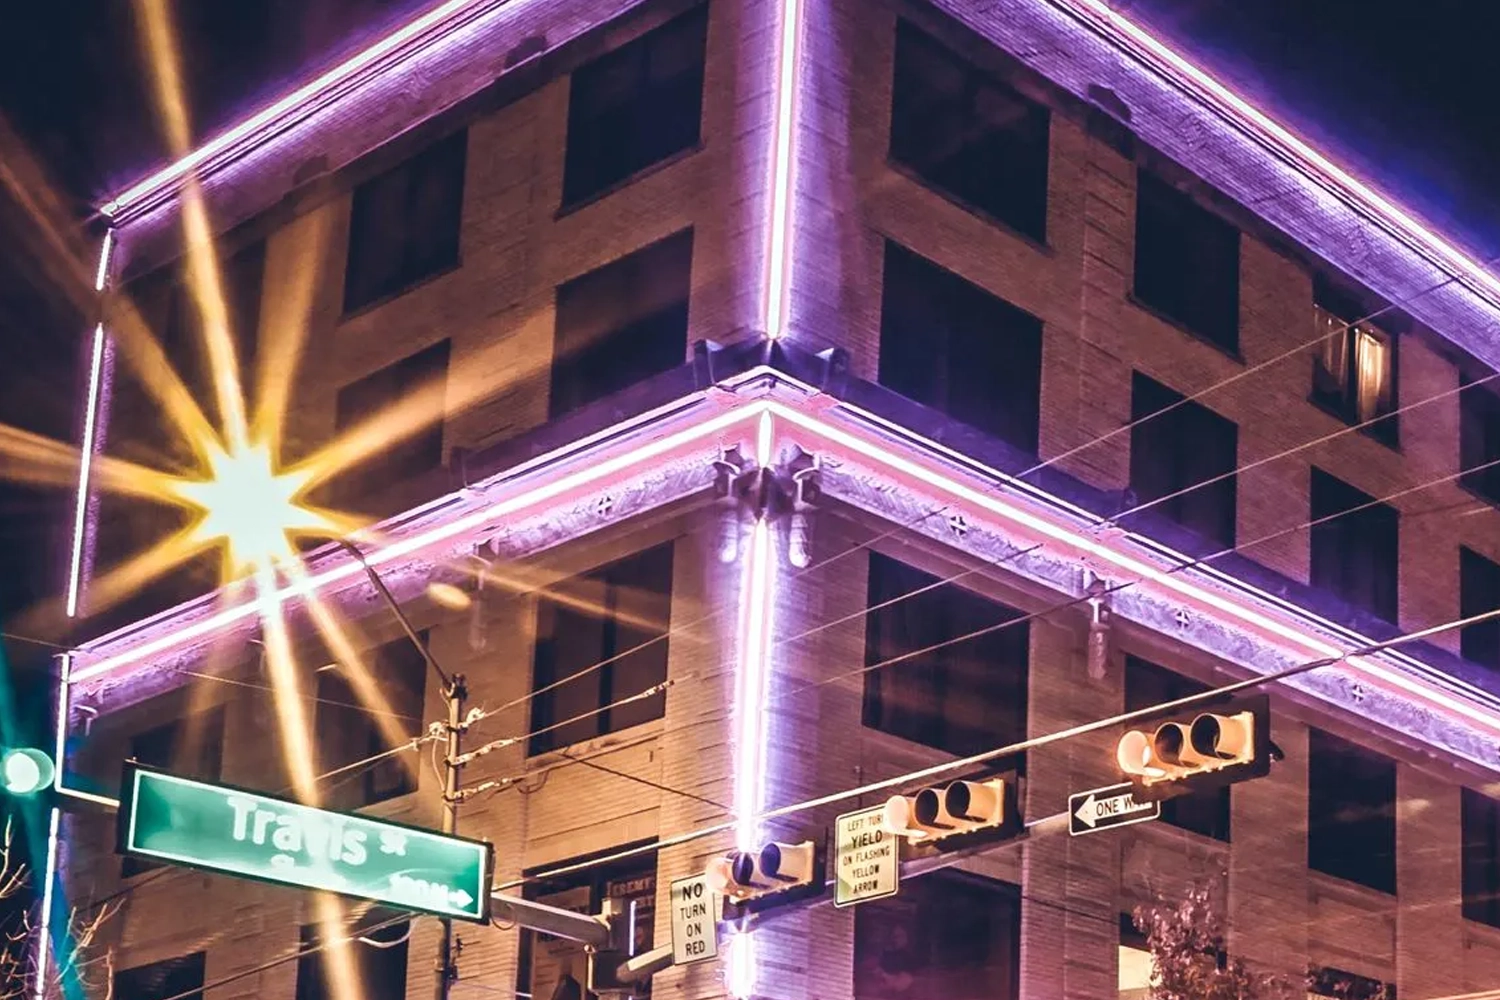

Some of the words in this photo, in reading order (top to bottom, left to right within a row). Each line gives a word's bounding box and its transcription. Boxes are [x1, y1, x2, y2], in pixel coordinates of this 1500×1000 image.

[1096, 799, 1119, 816] ONE
[227, 796, 367, 865] Travis
[847, 819, 864, 832] LEFT
[868, 814, 884, 828] TUR
[851, 829, 883, 849] YIELD
[843, 856, 852, 866] ON
[856, 845, 890, 863] FLASHING
[852, 864, 880, 879] YELLOW
[682, 882, 703, 901] NO
[853, 880, 879, 894] ARROW
[680, 903, 706, 920] TURN
[686, 922, 702, 938] ON
[685, 940, 705, 956] RED
